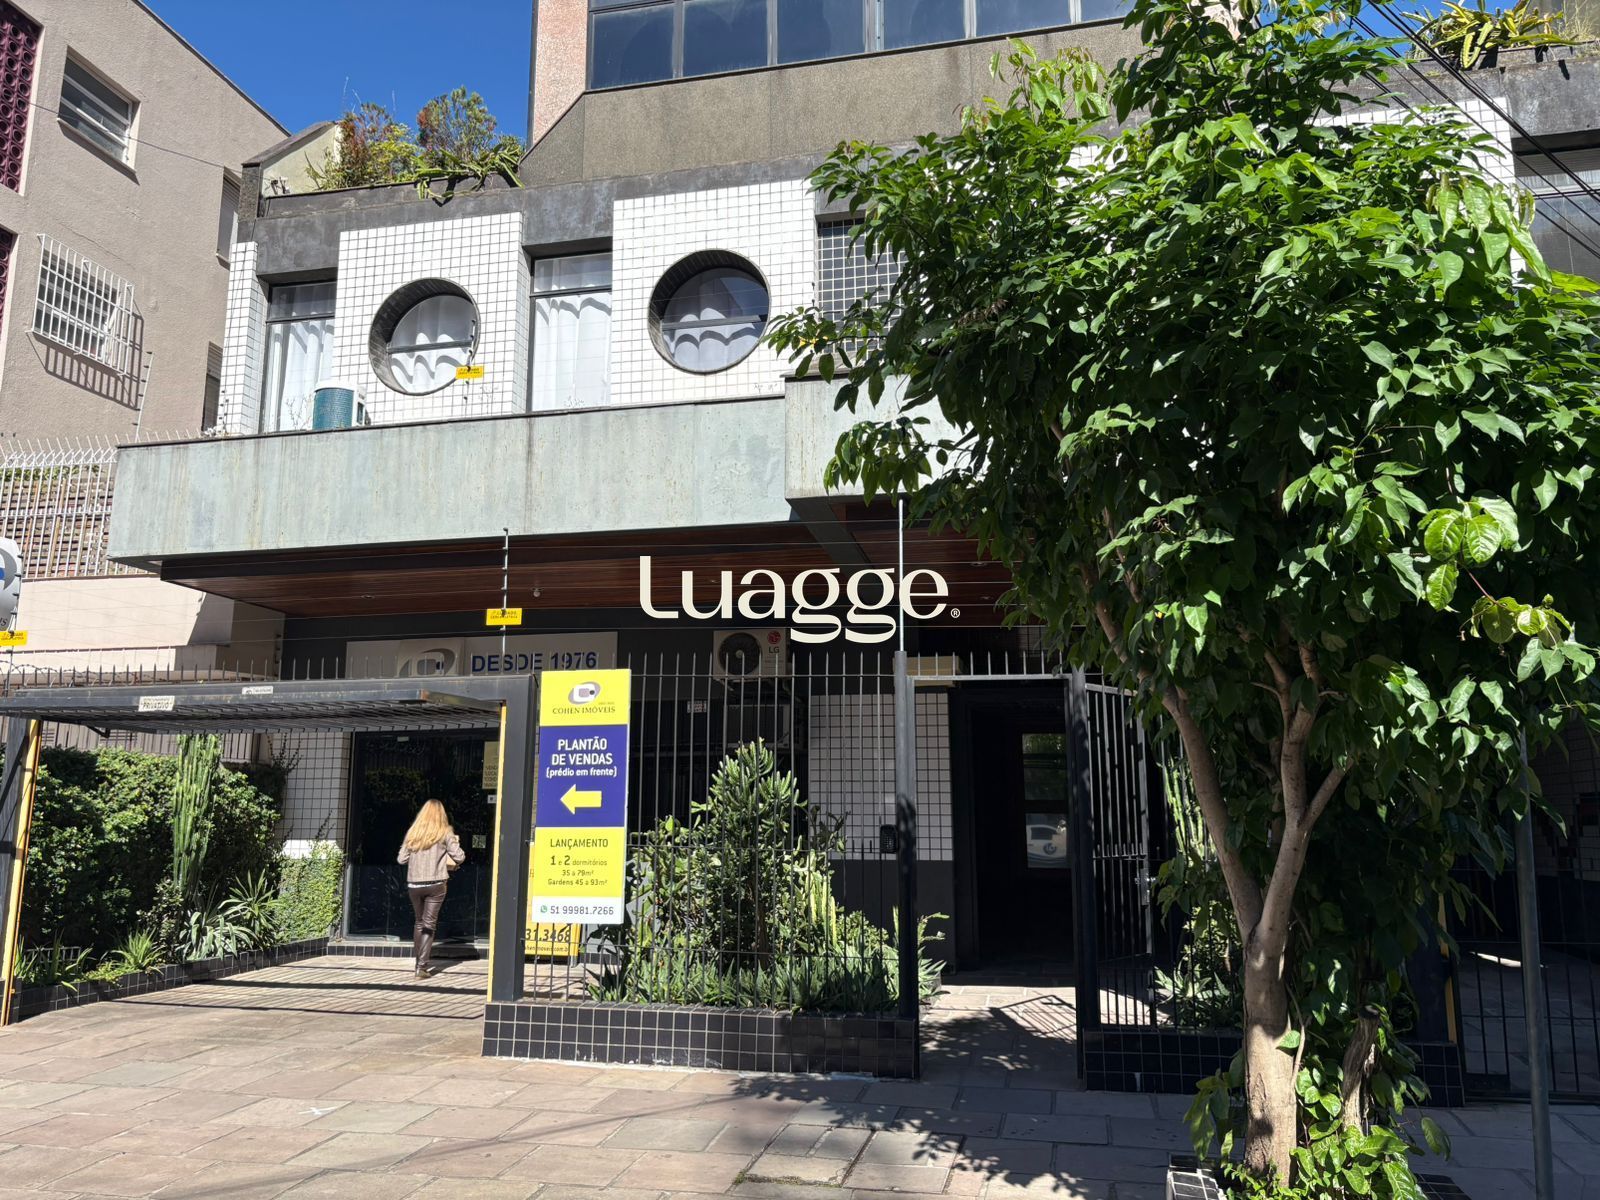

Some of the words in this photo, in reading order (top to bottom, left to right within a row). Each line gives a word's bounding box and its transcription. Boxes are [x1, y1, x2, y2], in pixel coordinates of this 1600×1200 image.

[472, 653, 543, 672] DESDE
[550, 651, 597, 670] 1976
[582, 705, 616, 714] IMÓVEIS
[557, 736, 608, 751] PLANTÃO
[551, 753, 566, 766] DE
[568, 752, 613, 765] VENDAS
[550, 838, 609, 850] LANÇAMENTO
[550, 855, 556, 866] 1
[564, 854, 571, 866] 2
[550, 906, 560, 914] 51
[562, 906, 614, 915] 99981.7266
